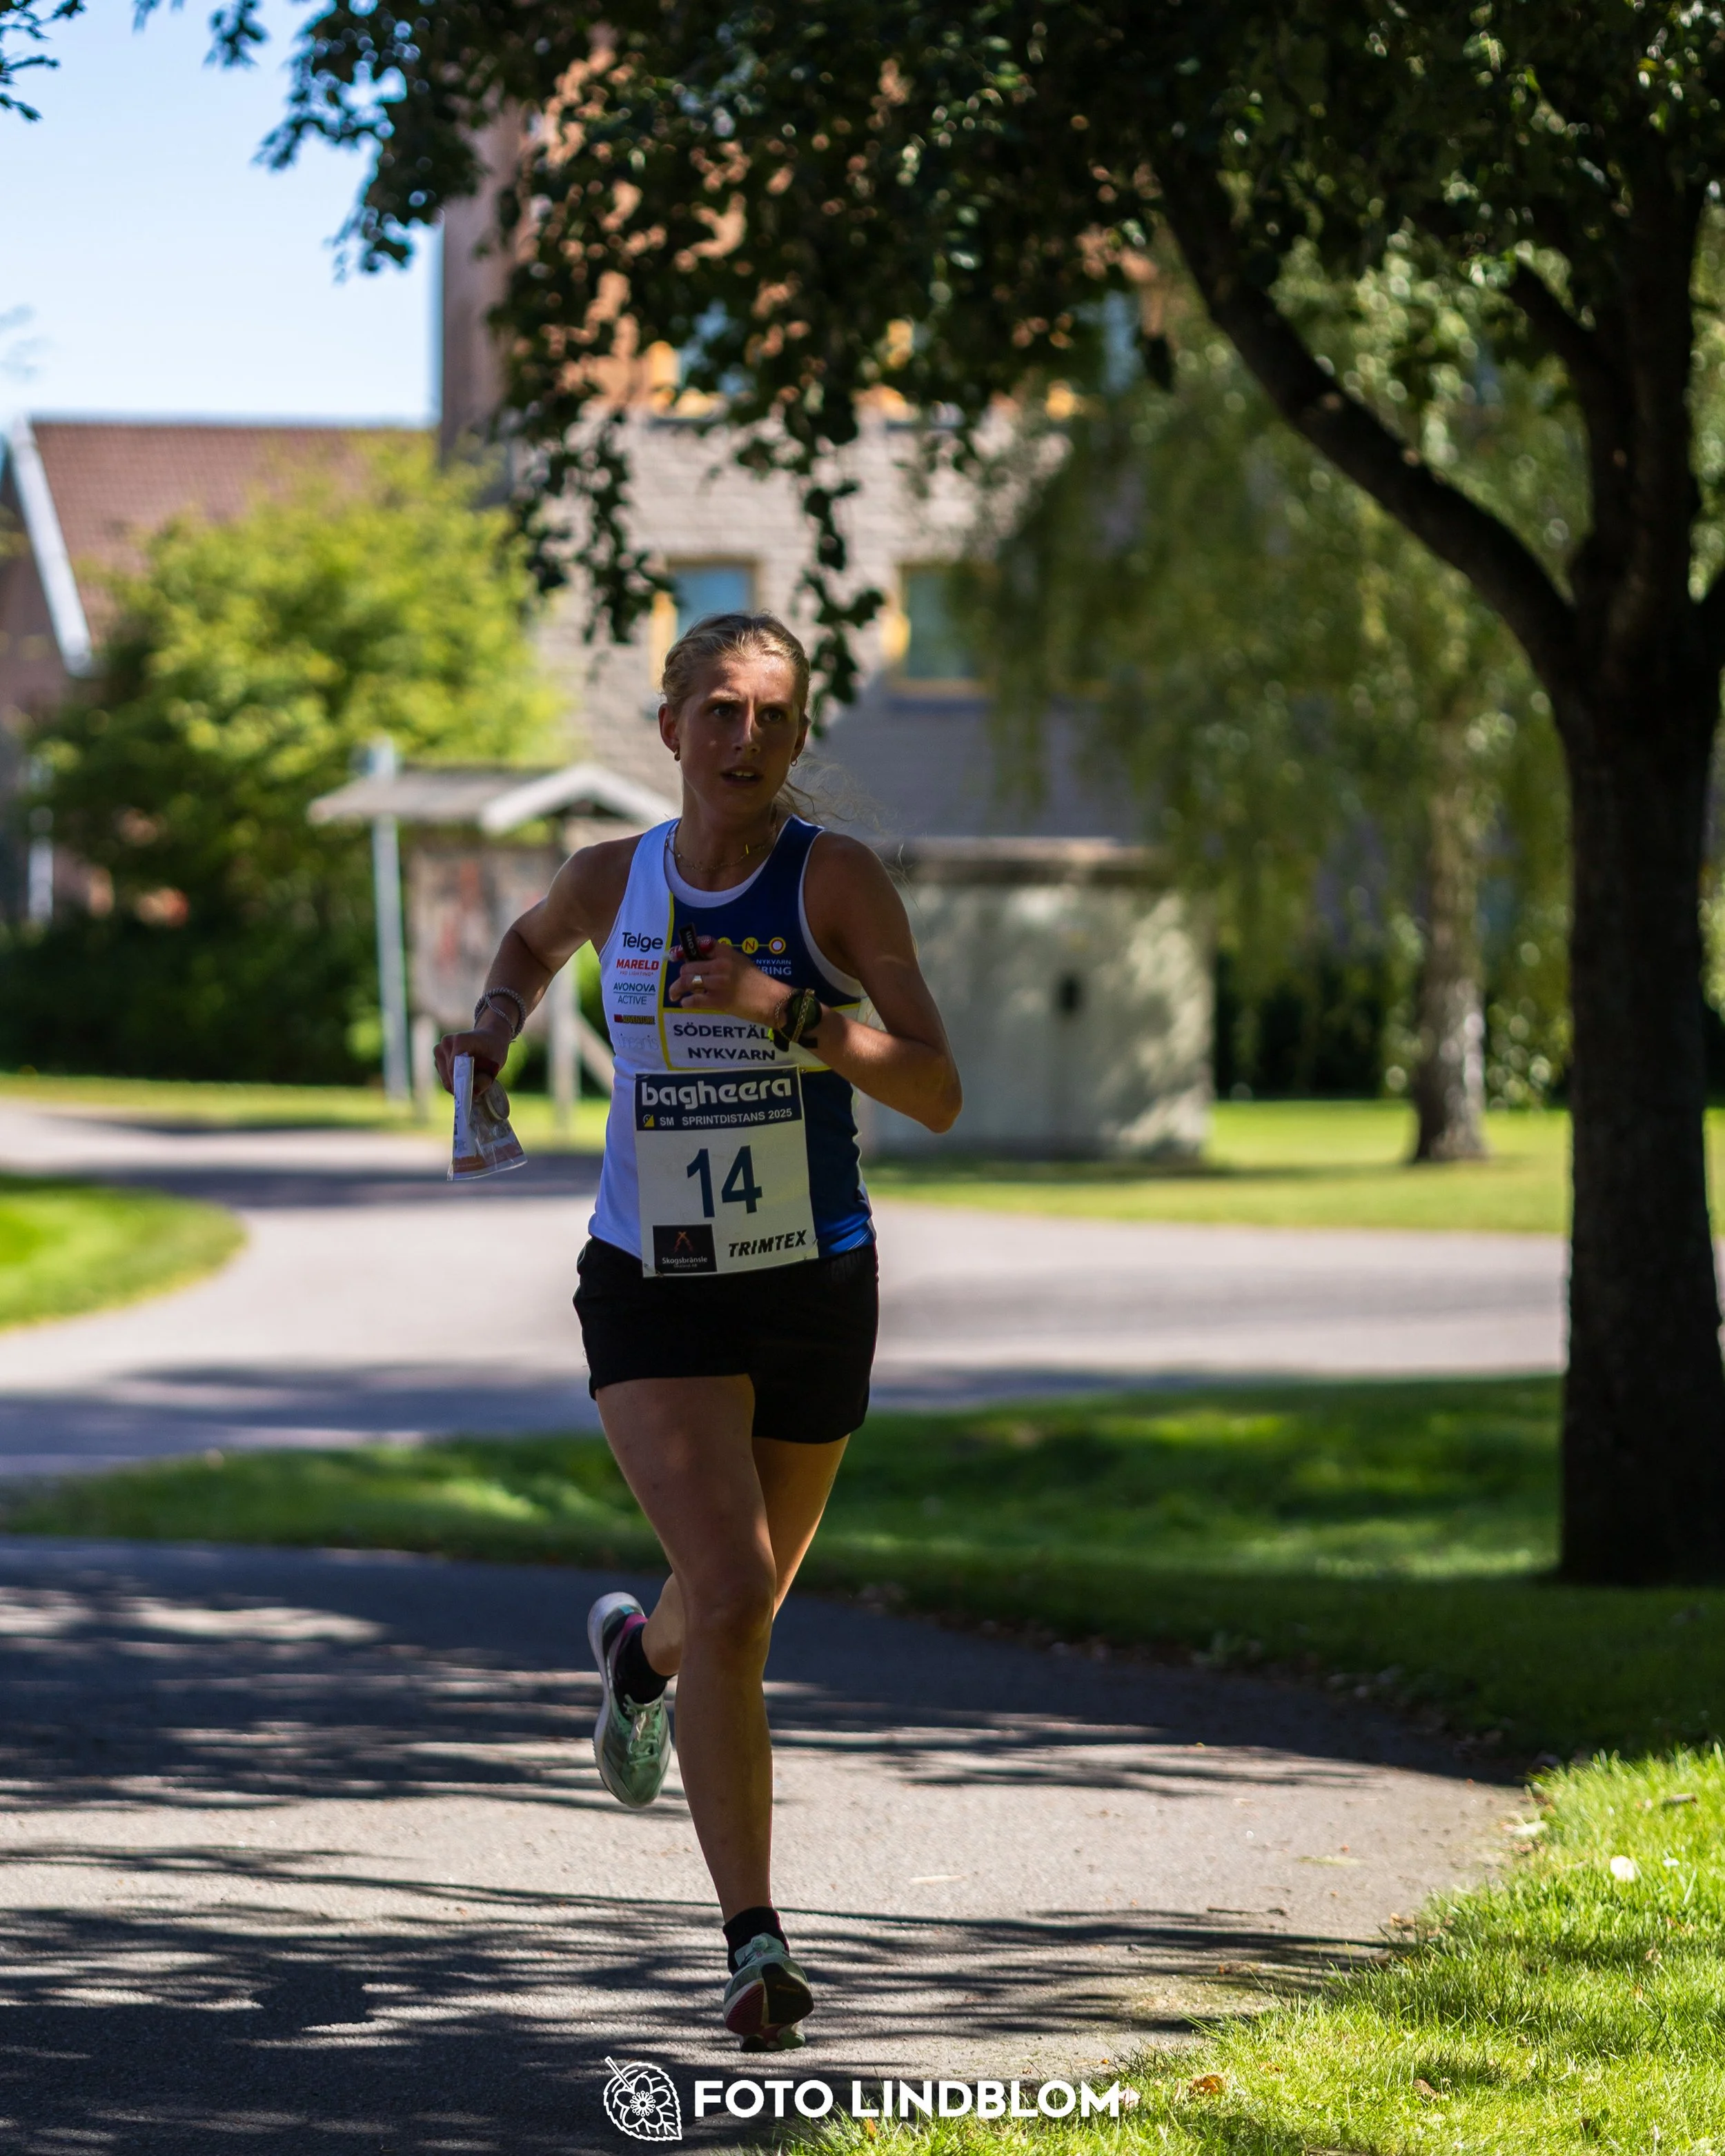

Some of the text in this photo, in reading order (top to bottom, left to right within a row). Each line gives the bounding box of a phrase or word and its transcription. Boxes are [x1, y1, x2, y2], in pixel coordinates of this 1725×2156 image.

[622, 931, 663, 952] Telge
[616, 958, 660, 971] MARELD
[758, 966, 791, 976] RING
[613, 982, 656, 992] AVONOVA
[618, 995, 647, 1005] ACTIVE
[673, 1022, 773, 1042] SÖDERTÄL
[688, 1047, 776, 1060] NYKVARN
[642, 1078, 792, 1110] bagheera
[660, 1107, 792, 1126] SM SPRINTDISTANS 2025
[687, 1145, 763, 1218] 14
[728, 1229, 807, 1258] TRIMTEX
